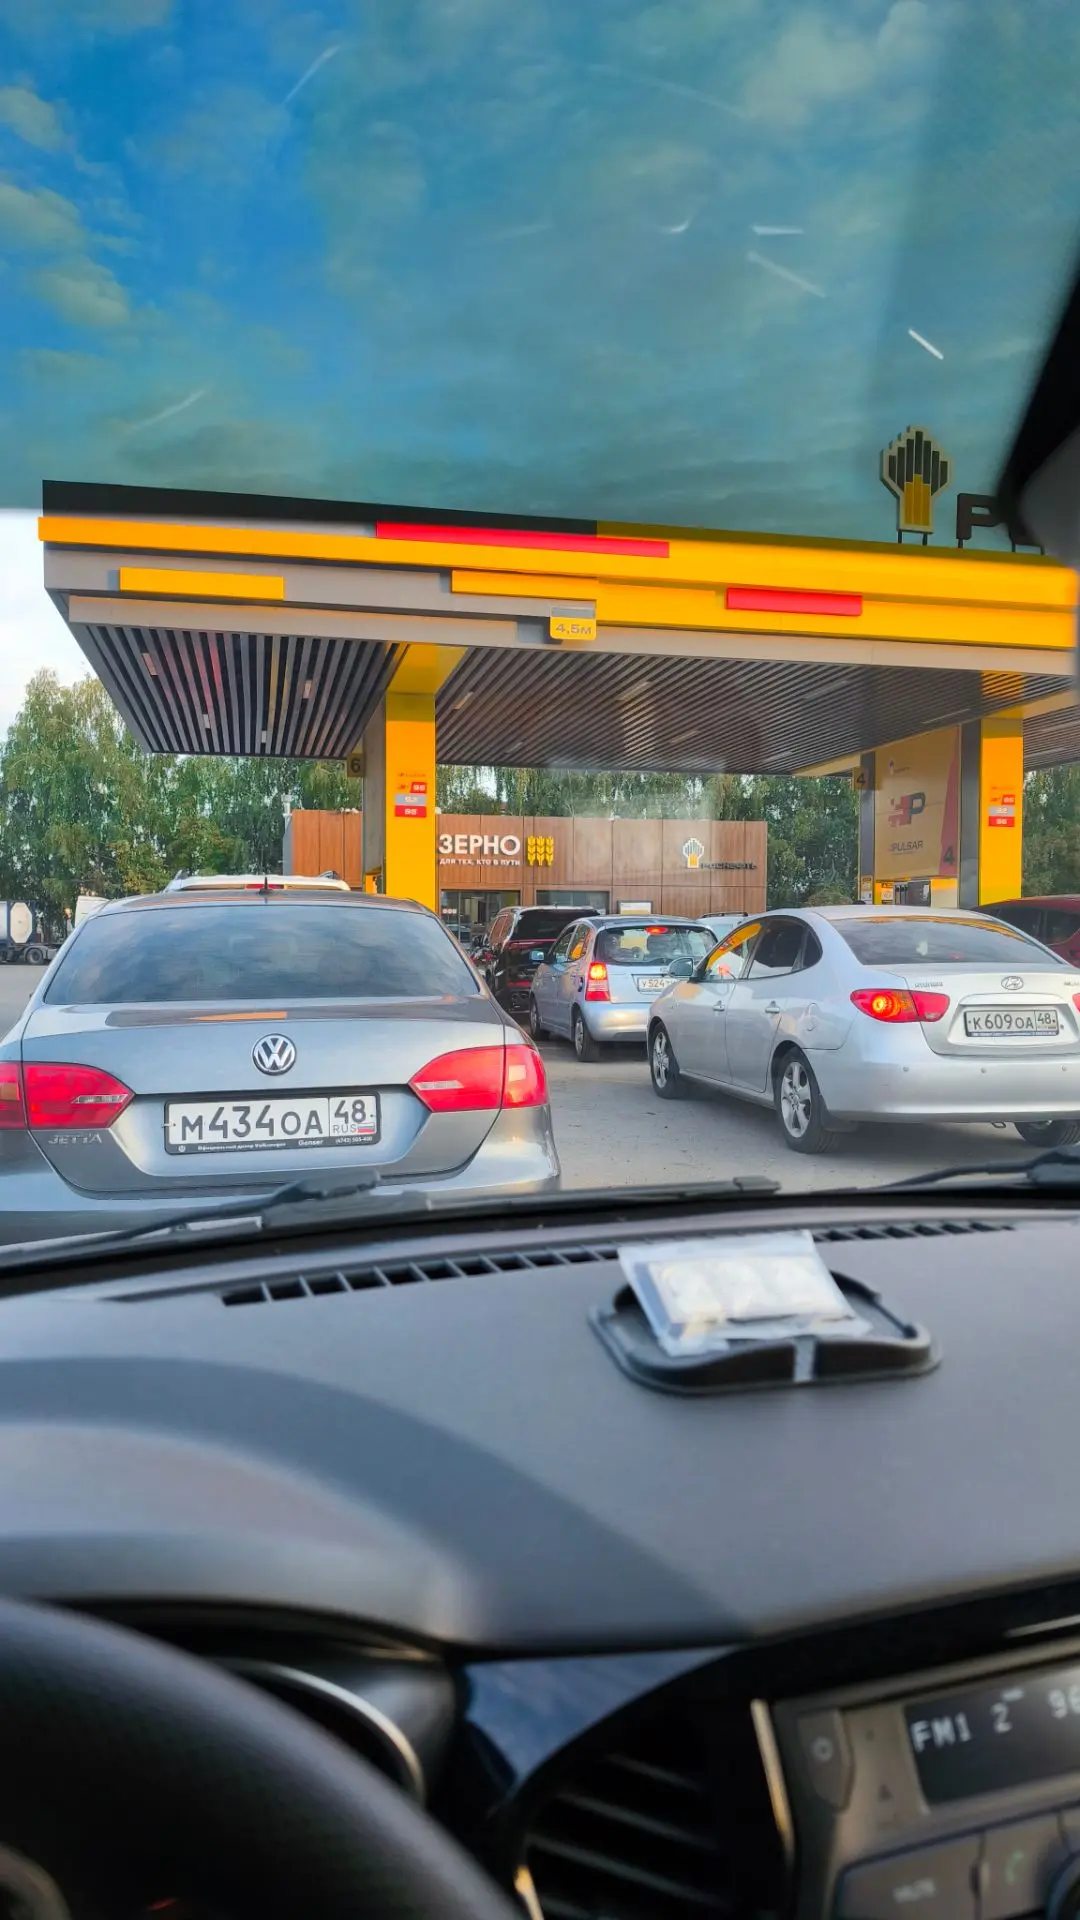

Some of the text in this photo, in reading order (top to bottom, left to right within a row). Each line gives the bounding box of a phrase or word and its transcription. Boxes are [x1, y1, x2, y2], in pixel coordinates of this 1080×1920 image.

[351, 757, 361, 773] 6
[856, 772, 866, 786] 4
[438, 834, 521, 856] ЗЕРНО
[943, 846, 955, 866] 4
[973, 1012, 1051, 1031] К609ОА 48
[181, 1099, 367, 1141] М434ОА 48
[332, 1123, 358, 1134] RUS
[48, 1133, 103, 1145] JETTA
[910, 1711, 972, 1753] FM1
[990, 1702, 1012, 1733] 2
